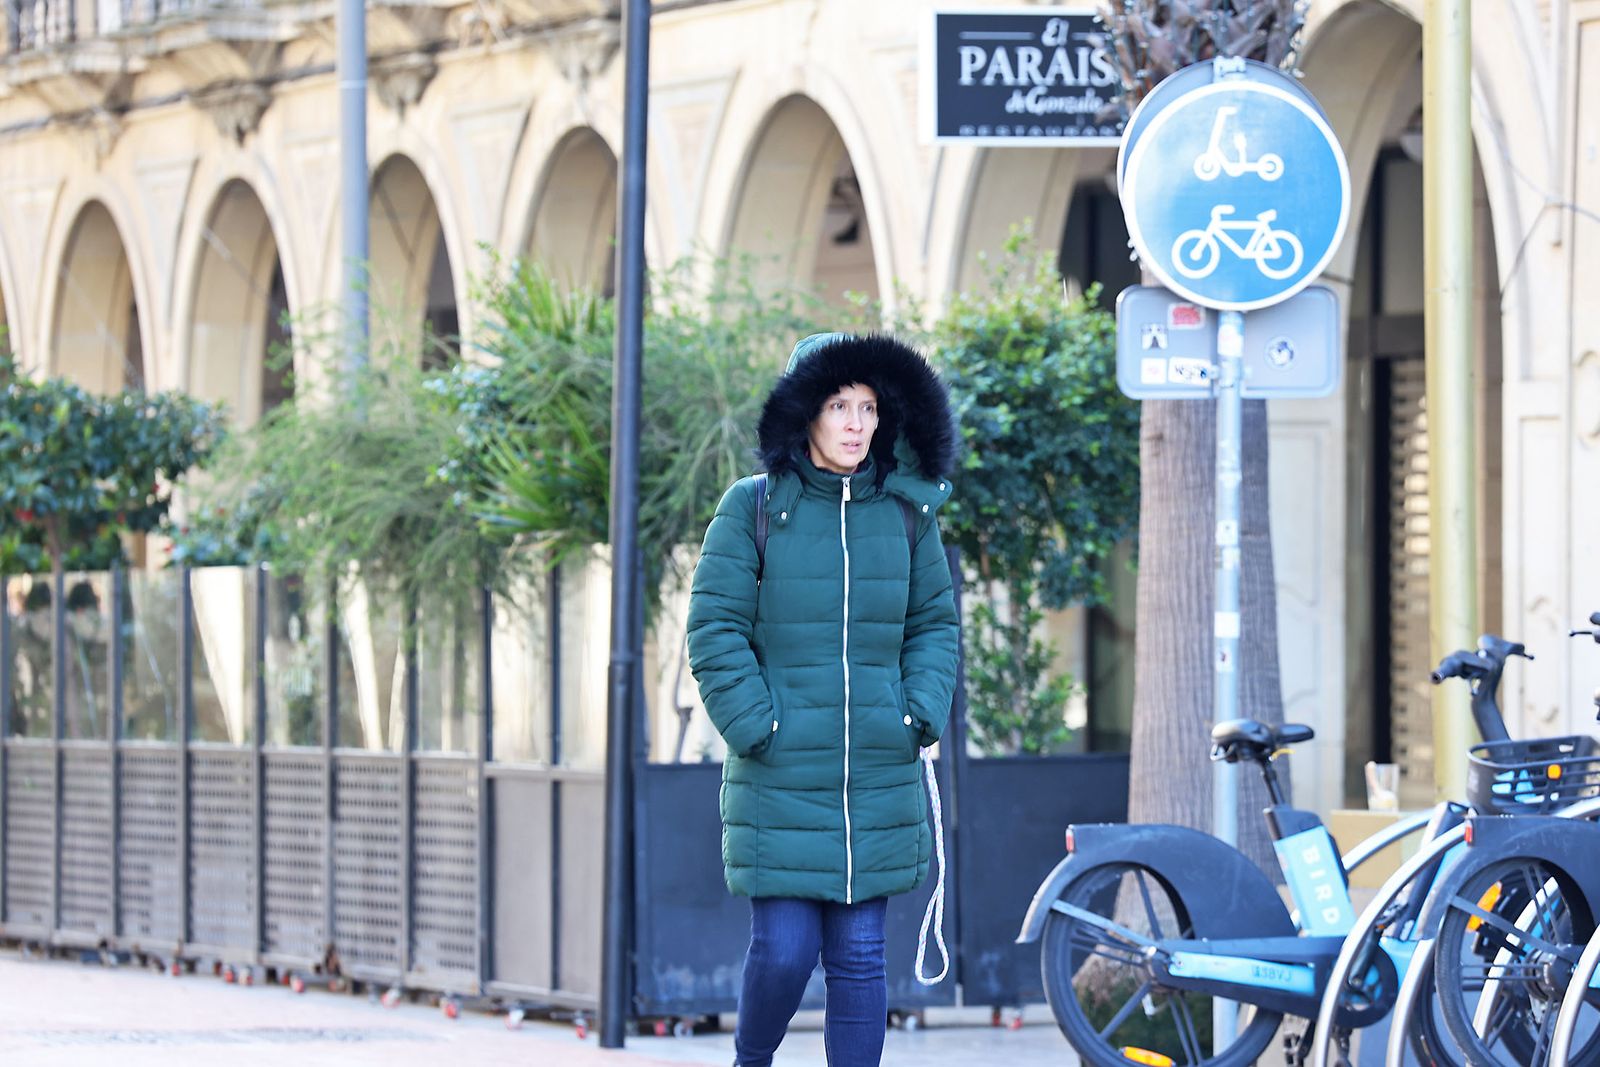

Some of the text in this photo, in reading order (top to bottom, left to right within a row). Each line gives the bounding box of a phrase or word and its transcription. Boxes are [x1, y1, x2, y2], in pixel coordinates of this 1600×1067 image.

[1042, 17, 1069, 46] El
[958, 45, 1116, 87] PARAIS
[959, 124, 1117, 137] RESTAURAN
[1303, 845, 1339, 924] BIRD
